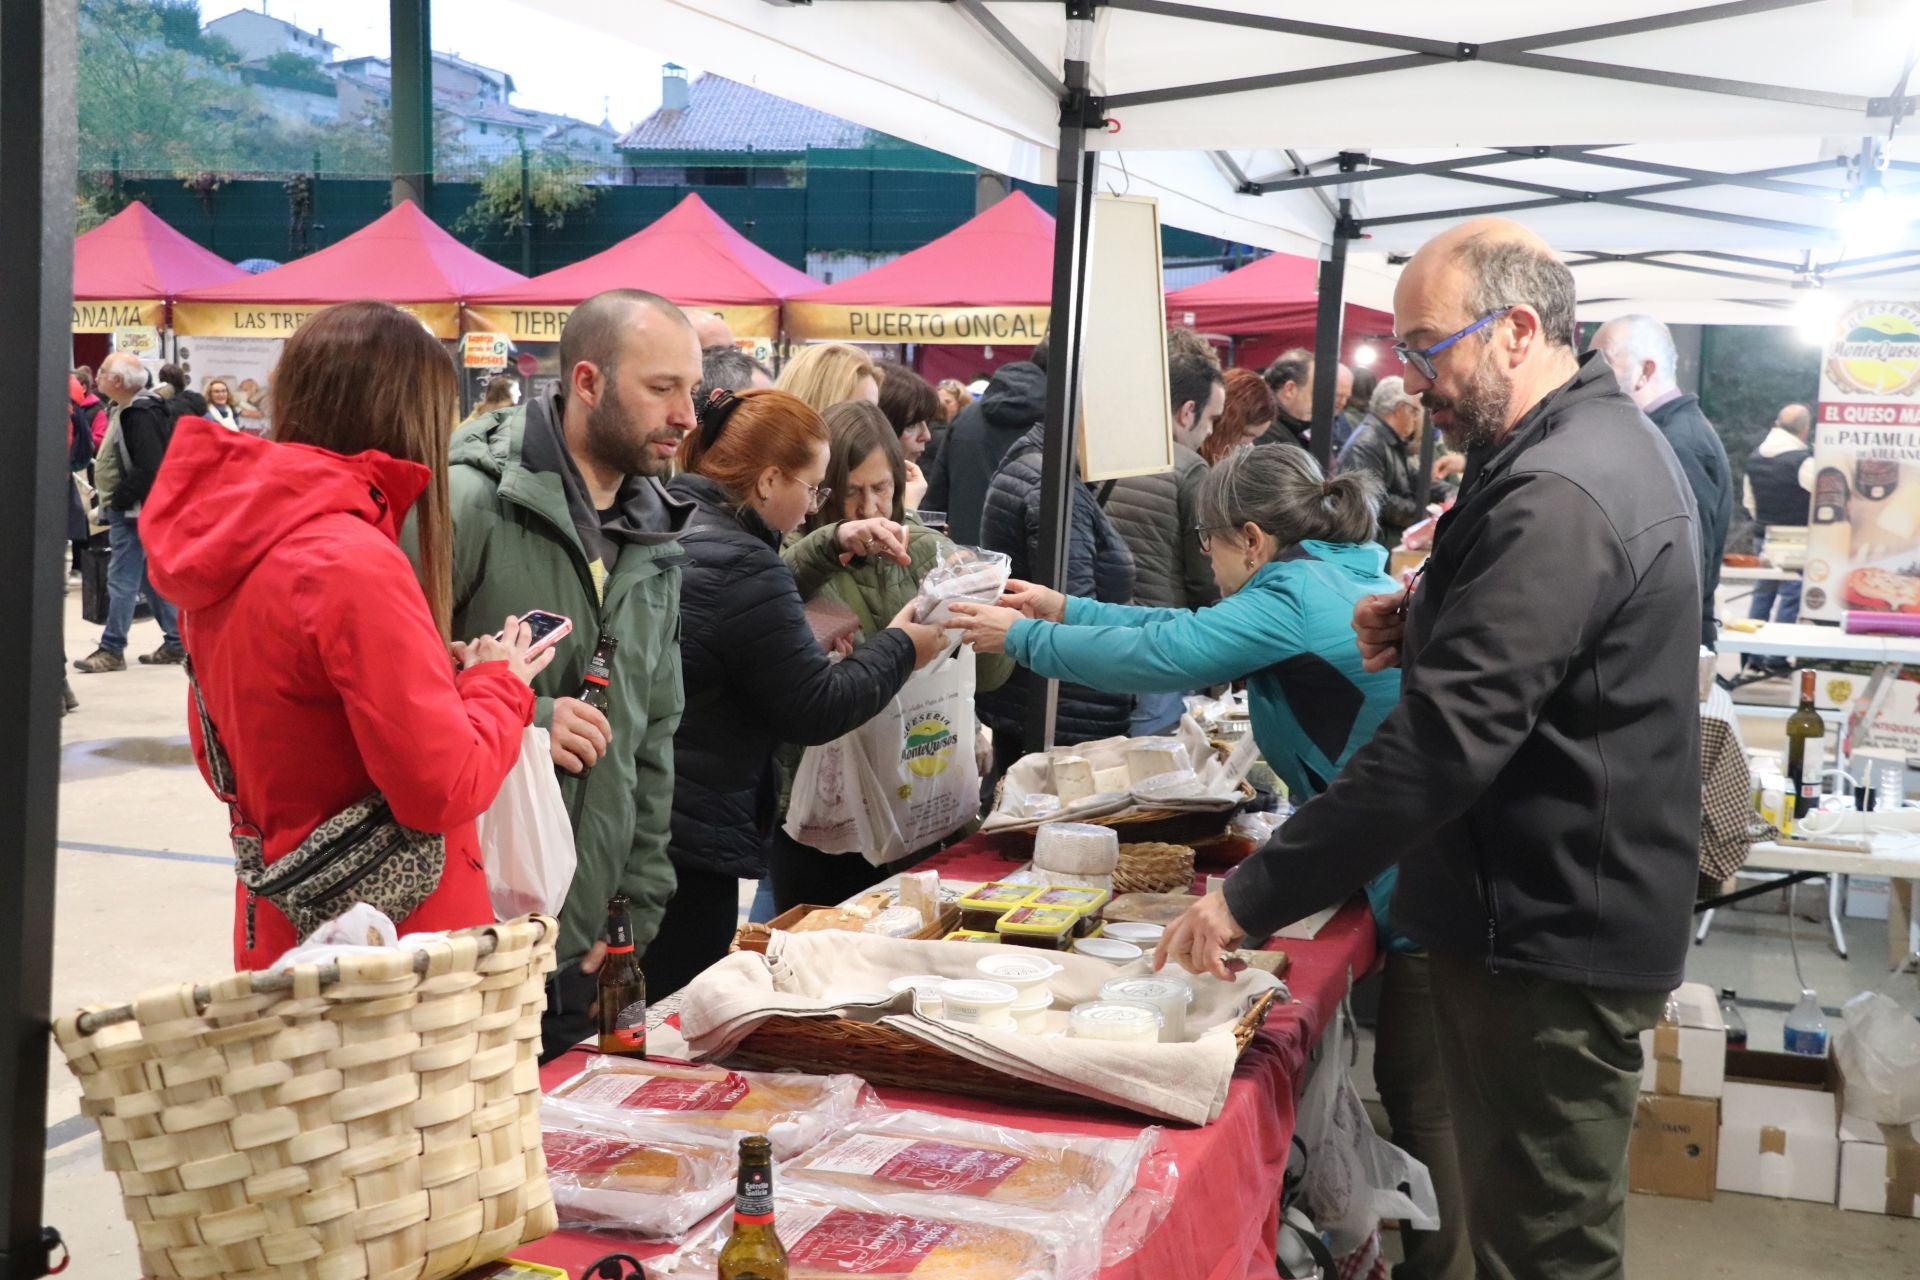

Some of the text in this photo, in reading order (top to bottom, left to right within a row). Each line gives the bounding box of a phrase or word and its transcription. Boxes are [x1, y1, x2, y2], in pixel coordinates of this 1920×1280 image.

[234, 312, 312, 329] LAS TRE
[850, 312, 945, 337] PUERTO
[1825, 405, 1840, 421] EL
[1843, 406, 1897, 424] QUESO
[1839, 430, 1920, 448] PATAMUL
